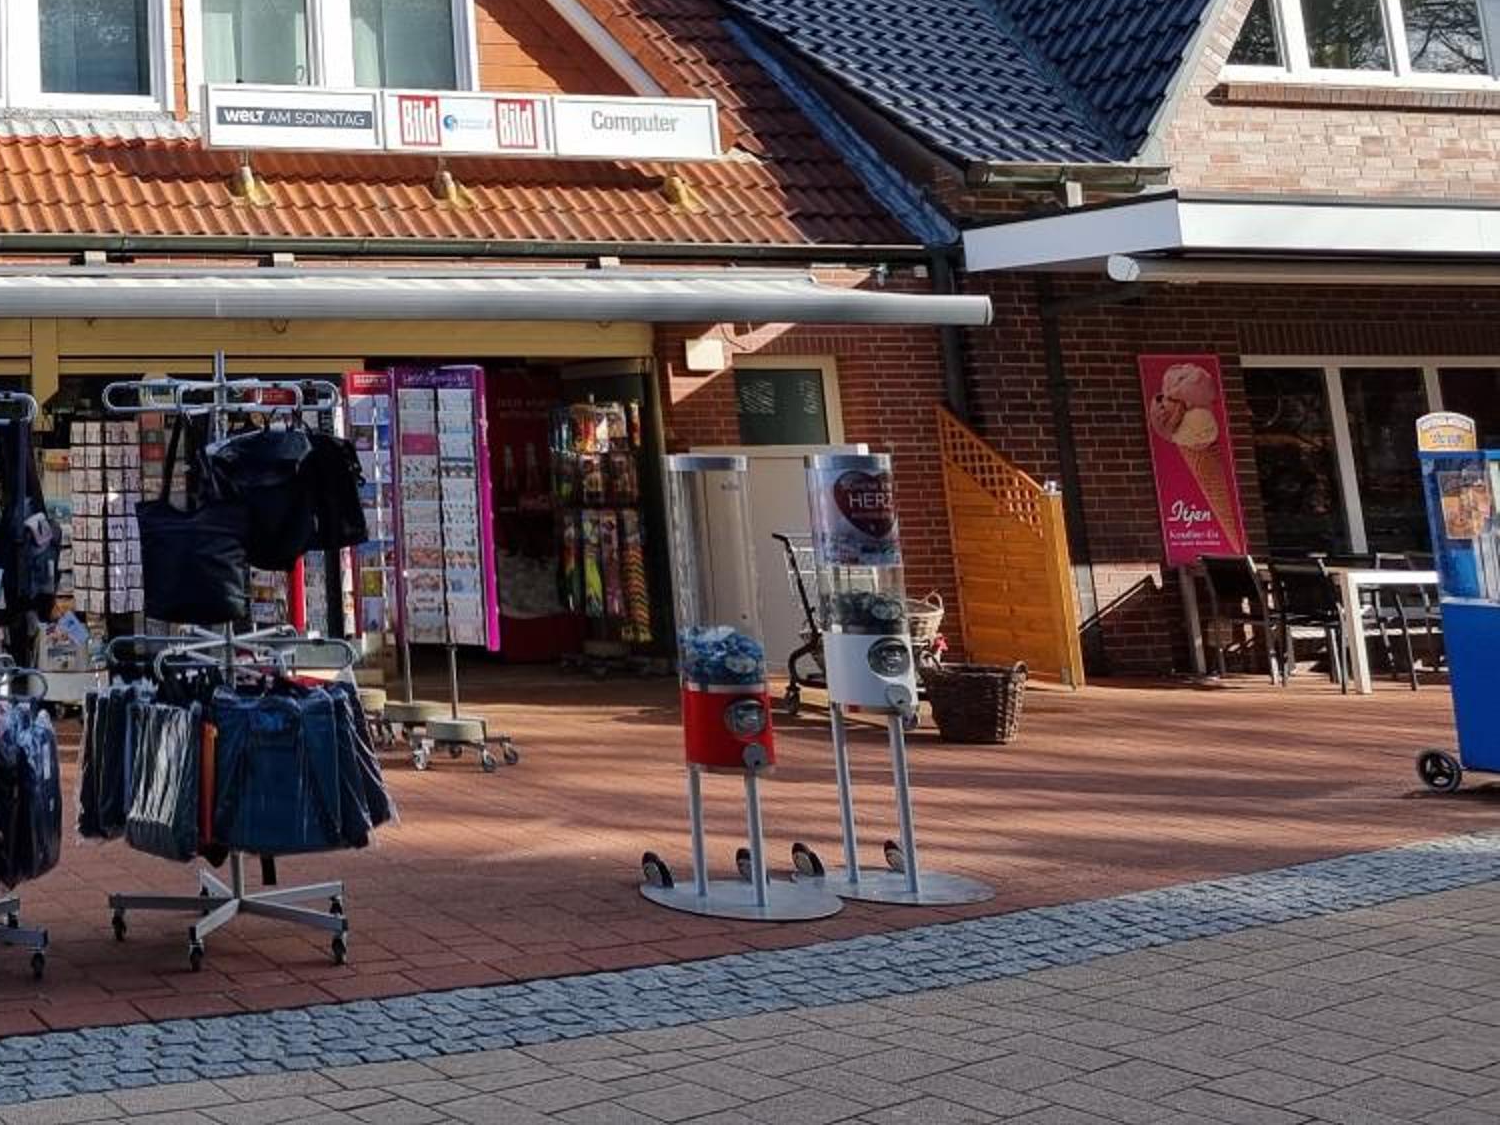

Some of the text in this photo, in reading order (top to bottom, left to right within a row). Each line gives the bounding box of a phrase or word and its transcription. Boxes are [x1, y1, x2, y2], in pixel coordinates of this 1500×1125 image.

[267, 112, 291, 125] AM
[295, 114, 365, 126] SONNTAG
[402, 97, 440, 145] Bild
[498, 102, 535, 148] Bild
[591, 110, 678, 135] Computer
